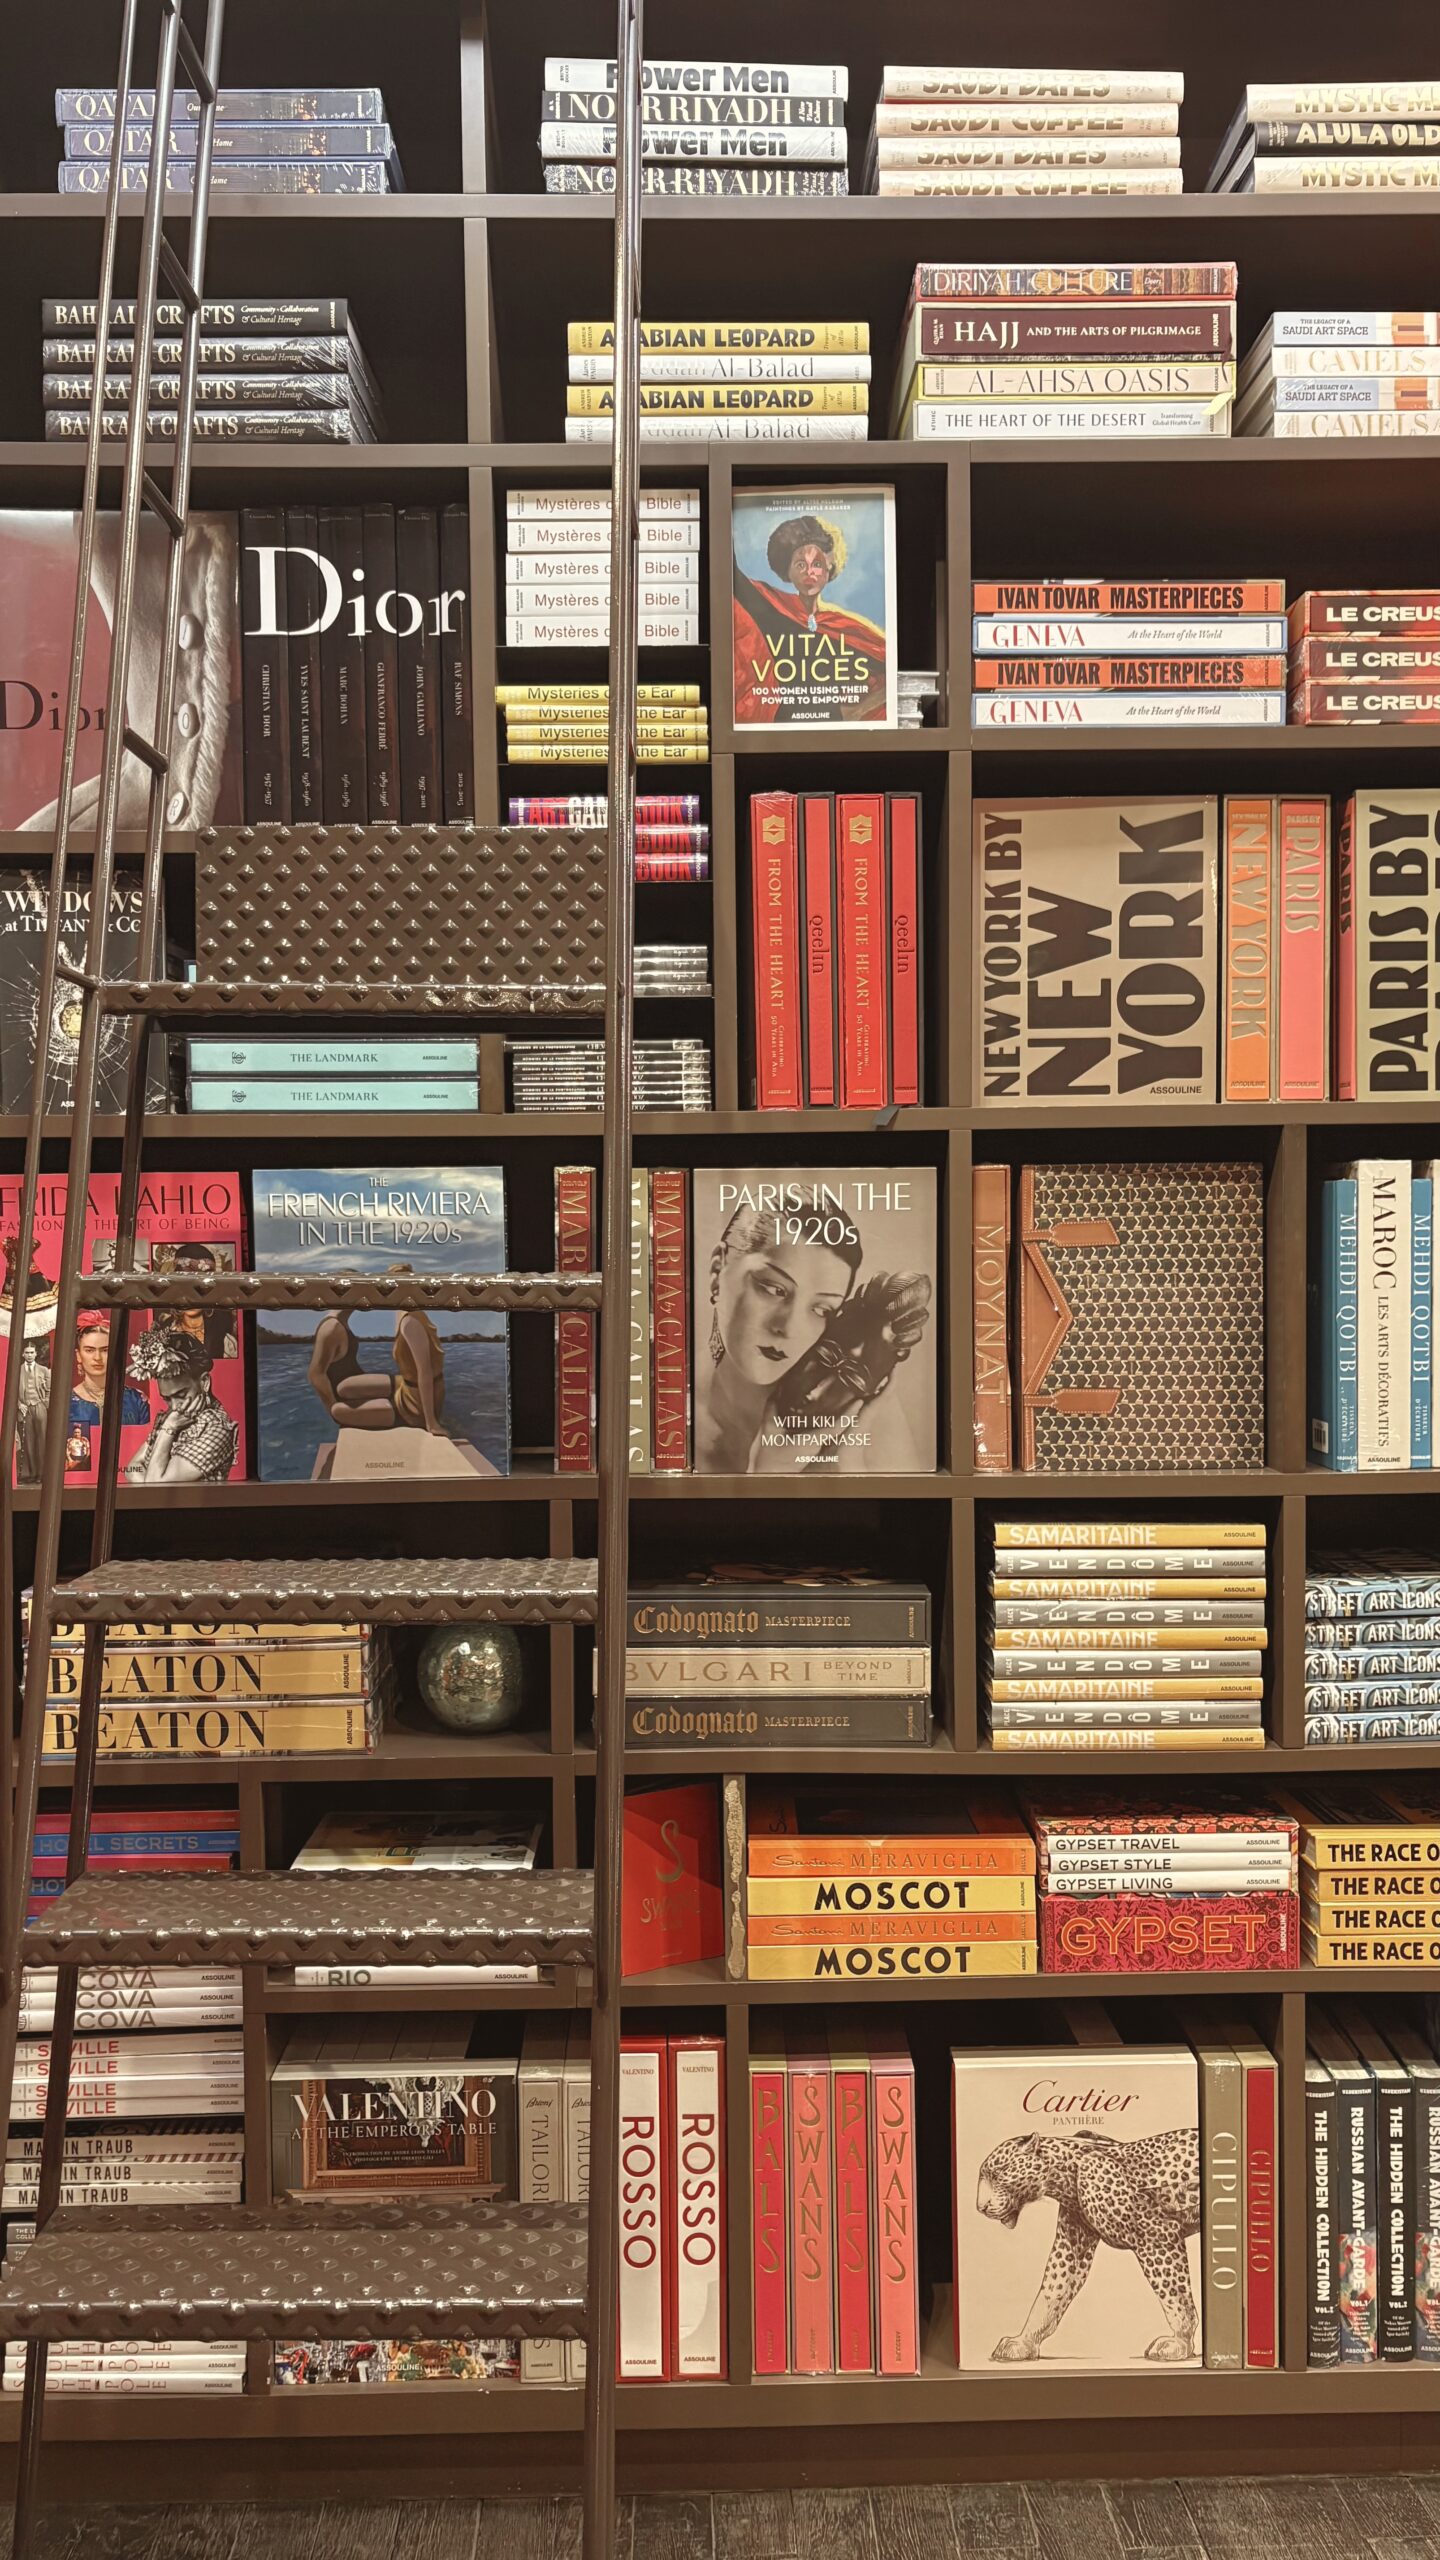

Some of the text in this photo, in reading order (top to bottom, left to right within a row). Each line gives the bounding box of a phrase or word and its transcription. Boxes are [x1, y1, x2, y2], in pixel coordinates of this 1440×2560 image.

[722, 66, 789, 94] Men
[922, 71, 1009, 95] SAUDI
[1018, 73, 1111, 97] DATES
[670, 95, 793, 125] RIYADH
[1295, 87, 1400, 113] MYSTIC
[1295, 122, 1389, 144] ALULA
[933, 270, 1133, 292] DIRIYAH CULTURE
[251, 314, 303, 326] Cultural Heritage
[1282, 326, 1369, 336] SAUDI ART SPACE
[714, 328, 815, 348] LEOPARD
[954, 320, 1202, 349] HAJJ AND THE ARTS OF PILGRIMAGE
[712, 357, 814, 378] Al-Balad
[1308, 350, 1426, 373] CAMELS
[968, 367, 1190, 393] AL-AHSA OASIS
[945, 412, 1147, 428] THE HEART OF THE DESERT
[534, 562, 599, 577] Mystères
[645, 561, 680, 574] Bible
[244, 547, 466, 637] Dior
[997, 586, 1244, 610] IVAN TOVAR MASTERPIECES
[1326, 607, 1358, 622] LE
[766, 633, 854, 656] VITAL
[992, 624, 1223, 648] GENEVA At the Heart of the World
[752, 657, 869, 683] VOICES
[262, 664, 271, 737] CHRISTIAN DIOR
[416, 665, 425, 736] JOHN GALLIANO
[752, 685, 869, 696] 100 WOMEN USING THEIR
[761, 695, 860, 705] POWER TO EMPOWER
[1285, 827, 1321, 934] PARIS
[768, 858, 784, 1010] FROM THE HEART
[983, 813, 1022, 1097] NEW YORK BY
[1116, 810, 1205, 1095] YORK
[1369, 804, 1429, 1092] PARIS BY
[1027, 886, 1112, 1096] NEW
[290, 1053, 314, 1063] THE
[316, 1052, 379, 1063] LANDMARK
[1150, 1086, 1202, 1095] ASSOULINE
[368, 1177, 389, 1187] THE
[268, 1191, 490, 1218] FRENCH RIVIERA
[719, 1182, 911, 1212] PARIS IN THE
[159, 1217, 230, 1230] OF BEING
[299, 1220, 462, 1246] IN THE 1920s
[772, 1217, 858, 1246] 1920s
[1336, 1213, 1357, 1382] MEHDI QOTBI
[656, 1190, 683, 1448] MARIA by CALLAS
[974, 1225, 1006, 1404] MOYNAT
[1372, 1175, 1397, 1447] MAROC LES ARTS DÉCORATIFS
[773, 1416, 859, 1429] WITH KIKI DE
[761, 1433, 871, 1447] MONTPARNASSE
[1310, 1592, 1398, 1612] STREET ART
[634, 1604, 851, 1640] Codognato MASTERPIECE
[1010, 1631, 1159, 1650] SAMARITAINE
[824, 1661, 892, 1670] BEYOND
[838, 1673, 879, 1681] TIME
[110, 1836, 199, 1851] SECRETS
[1055, 1838, 1118, 1851] GYPSET
[1121, 1838, 1180, 1850] TRAVEL
[1328, 1843, 1422, 1862] THE RACE
[850, 1853, 999, 1870] MERAVIGLIA
[814, 1881, 969, 1911] MOSCOT
[1060, 1914, 1267, 1956] GYPSET
[328, 1969, 371, 1986] RIO
[77, 2010, 157, 2029] COVA
[622, 2068, 654, 2076] VALENTINO
[291, 2090, 497, 2121] VALENTINO
[1022, 2079, 1140, 2114] Cartier
[291, 2128, 311, 2140] AT
[316, 2127, 350, 2139] THE
[448, 2123, 497, 2136] TABLE
[1052, 2115, 1105, 2126] PANTHÈRE
[87, 2139, 133, 2155] TRAUB
[682, 2113, 716, 2266] ROSSO
[757, 2087, 782, 2273] BALS
[879, 2086, 909, 2284] SWANS
[1350, 2106, 1366, 2290] RUSSIAN AVANT-GARDE
[1389, 2106, 1404, 2297] THE HIDDEN COLLECTION
[1211, 2131, 1238, 2290] CIPULLO
